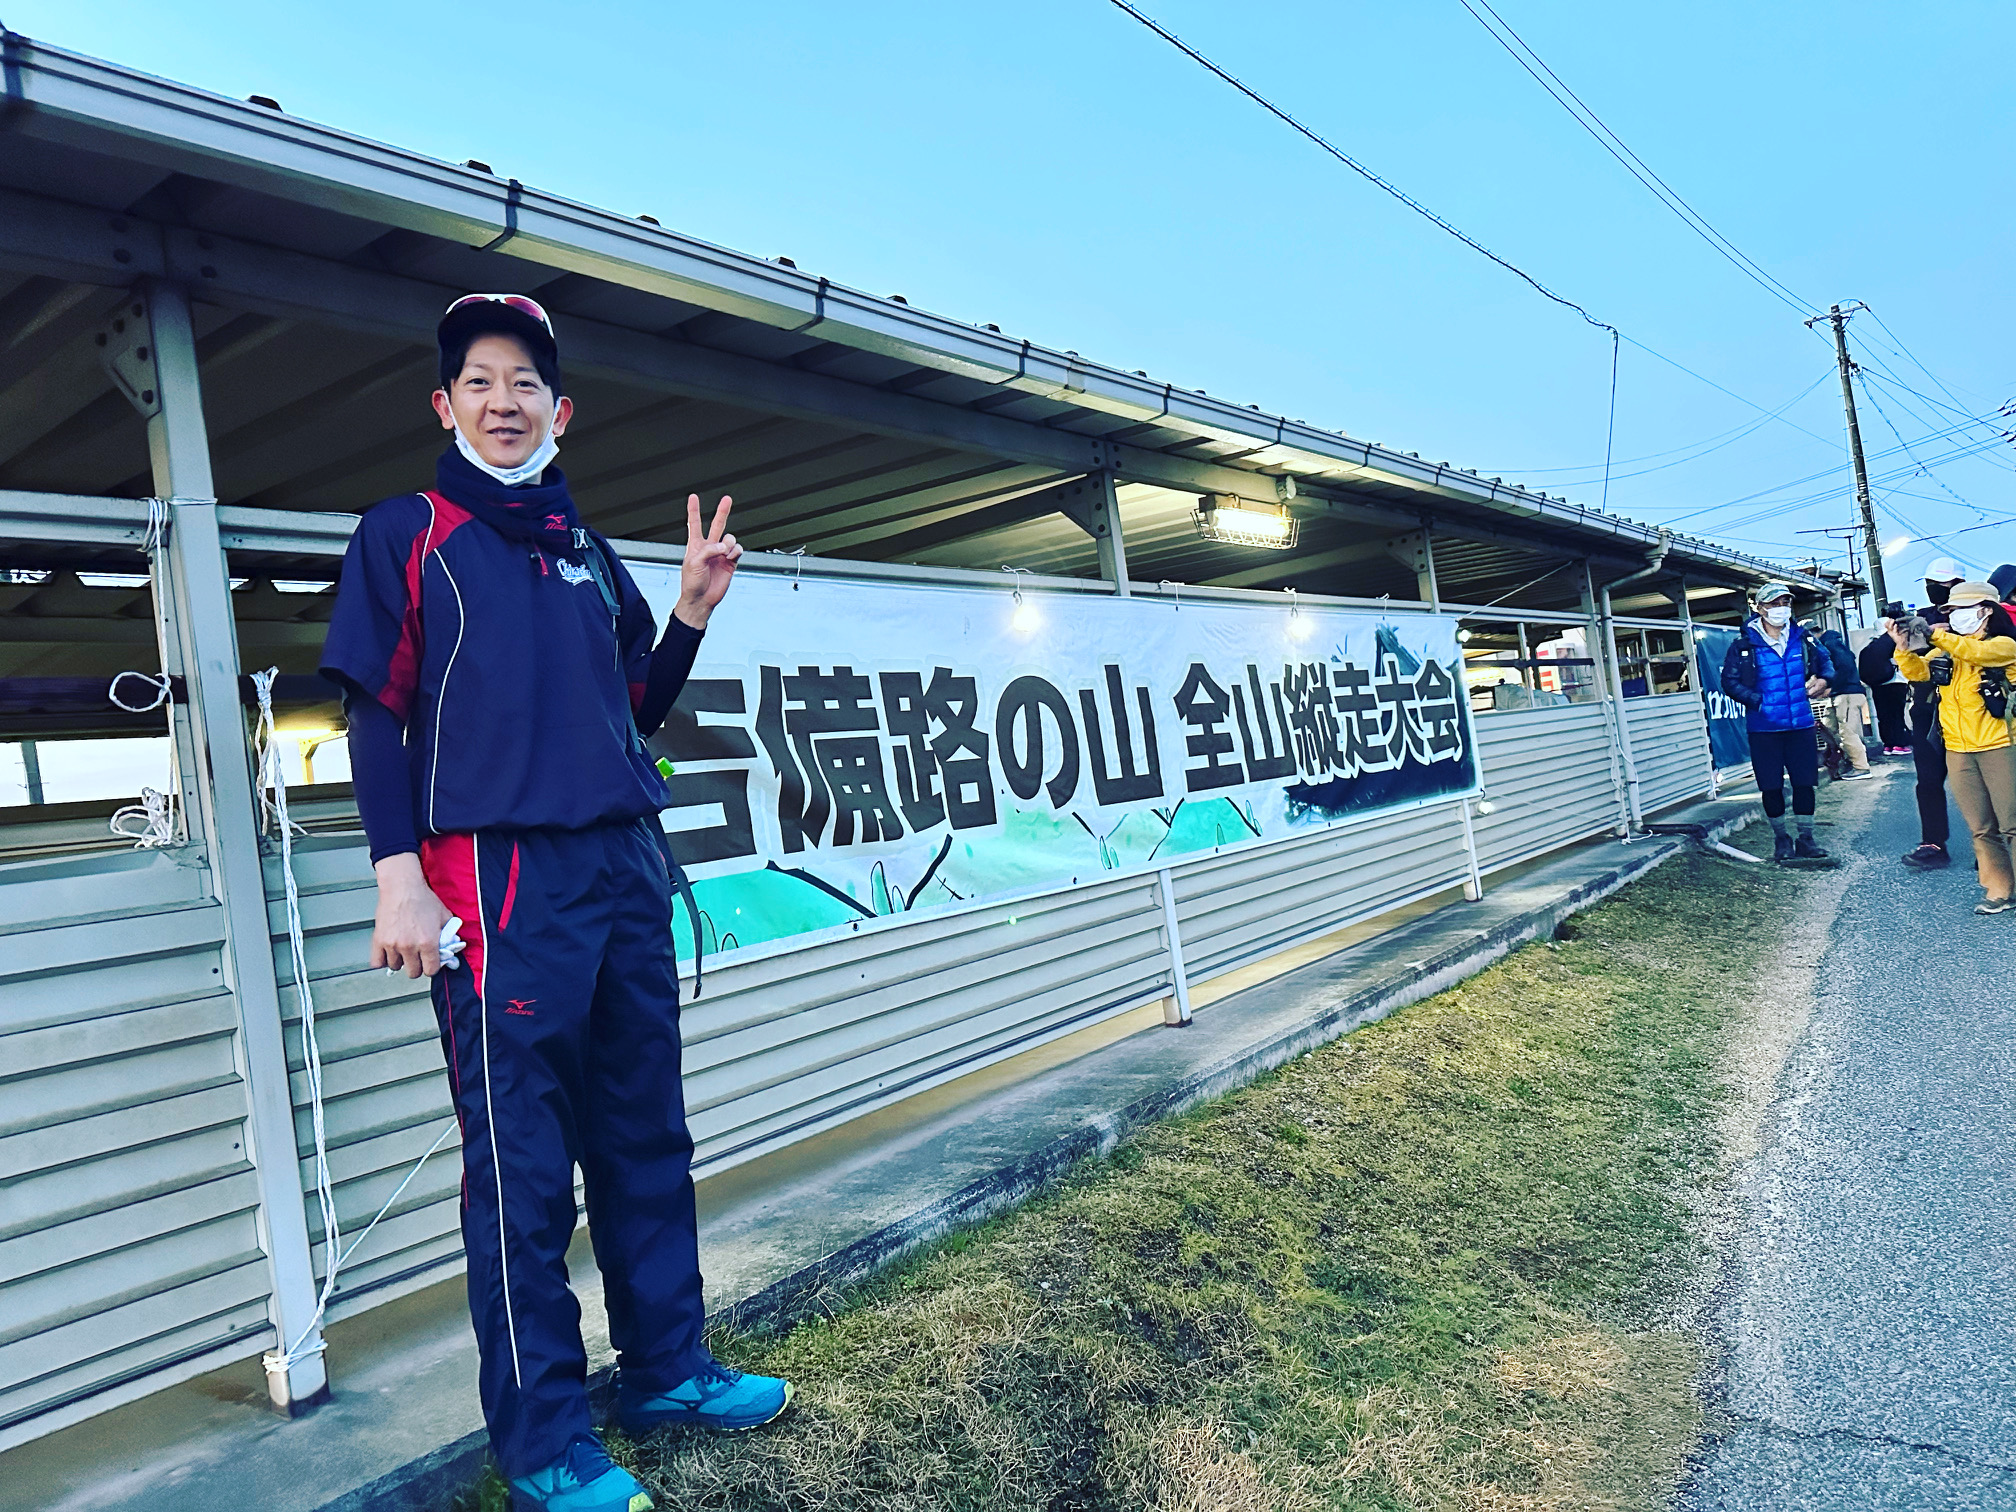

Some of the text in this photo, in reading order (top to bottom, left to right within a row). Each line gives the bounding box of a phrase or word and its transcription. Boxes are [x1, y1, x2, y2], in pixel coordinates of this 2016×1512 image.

[1173, 659, 1461, 793] 全山縦走大会
